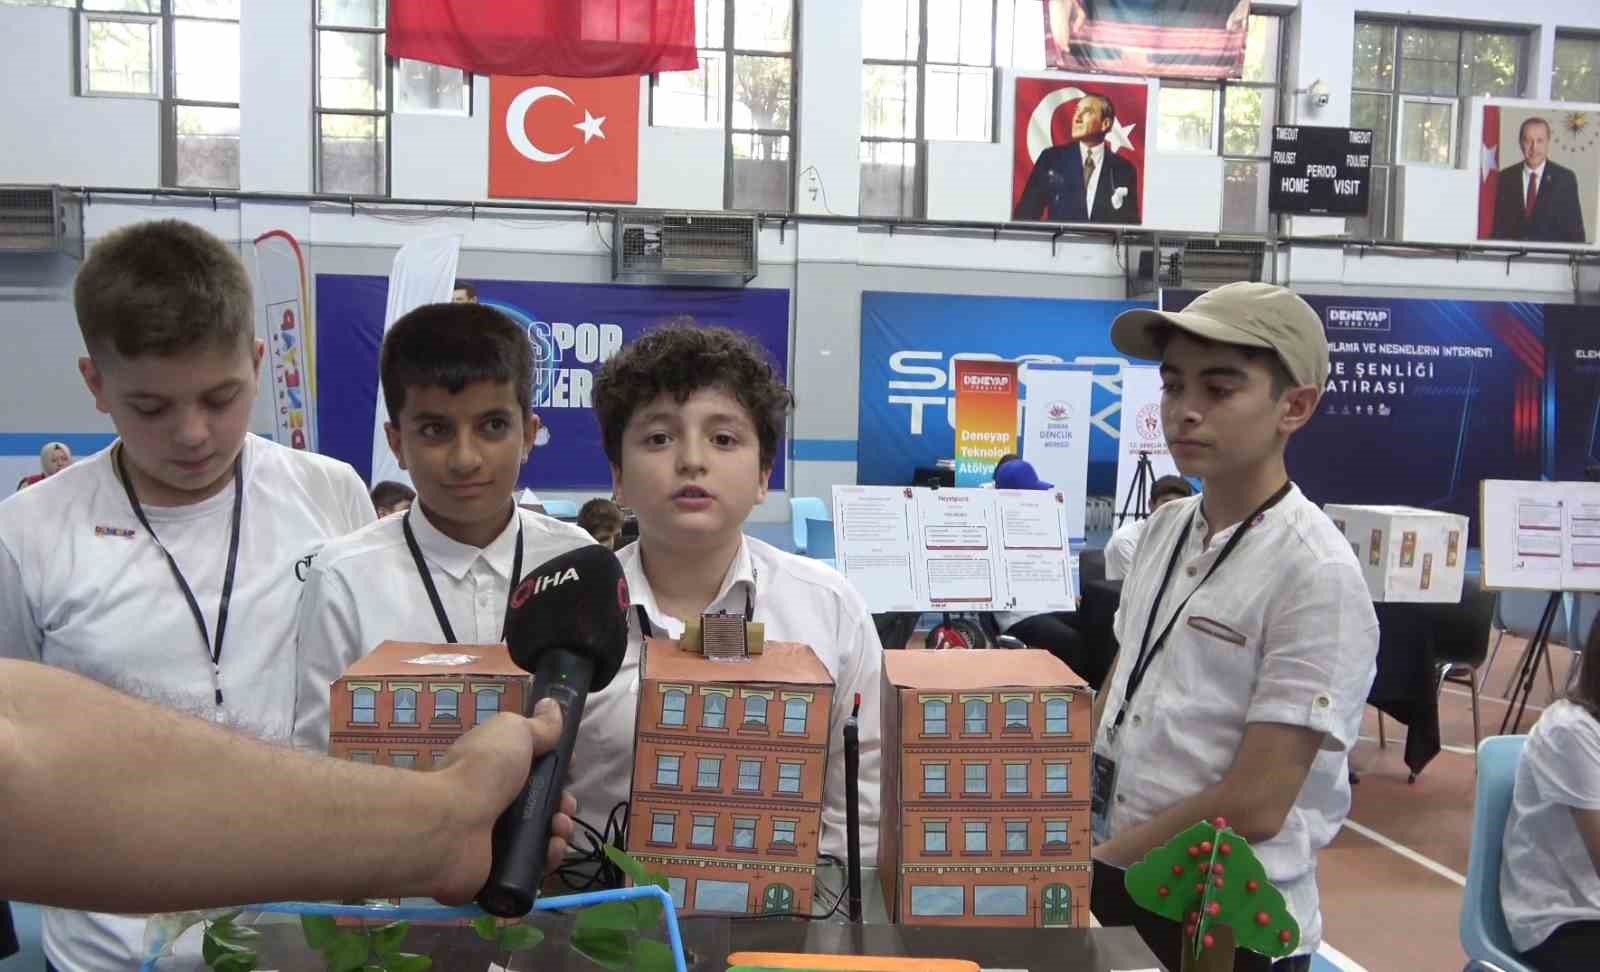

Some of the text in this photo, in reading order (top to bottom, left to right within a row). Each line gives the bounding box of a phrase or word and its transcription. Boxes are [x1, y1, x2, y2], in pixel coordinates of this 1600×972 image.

[1306, 164, 1337, 179] PERIOD
[1281, 177, 1310, 194] HOME
[1334, 180, 1360, 195] VISIT
[1330, 309, 1387, 322] DENEYAP
[528, 321, 623, 363] SPOR
[1362, 343, 1376, 353] VE
[1356, 361, 1434, 378] ŞENLİĞİ
[961, 430, 1009, 444] Deneyap
